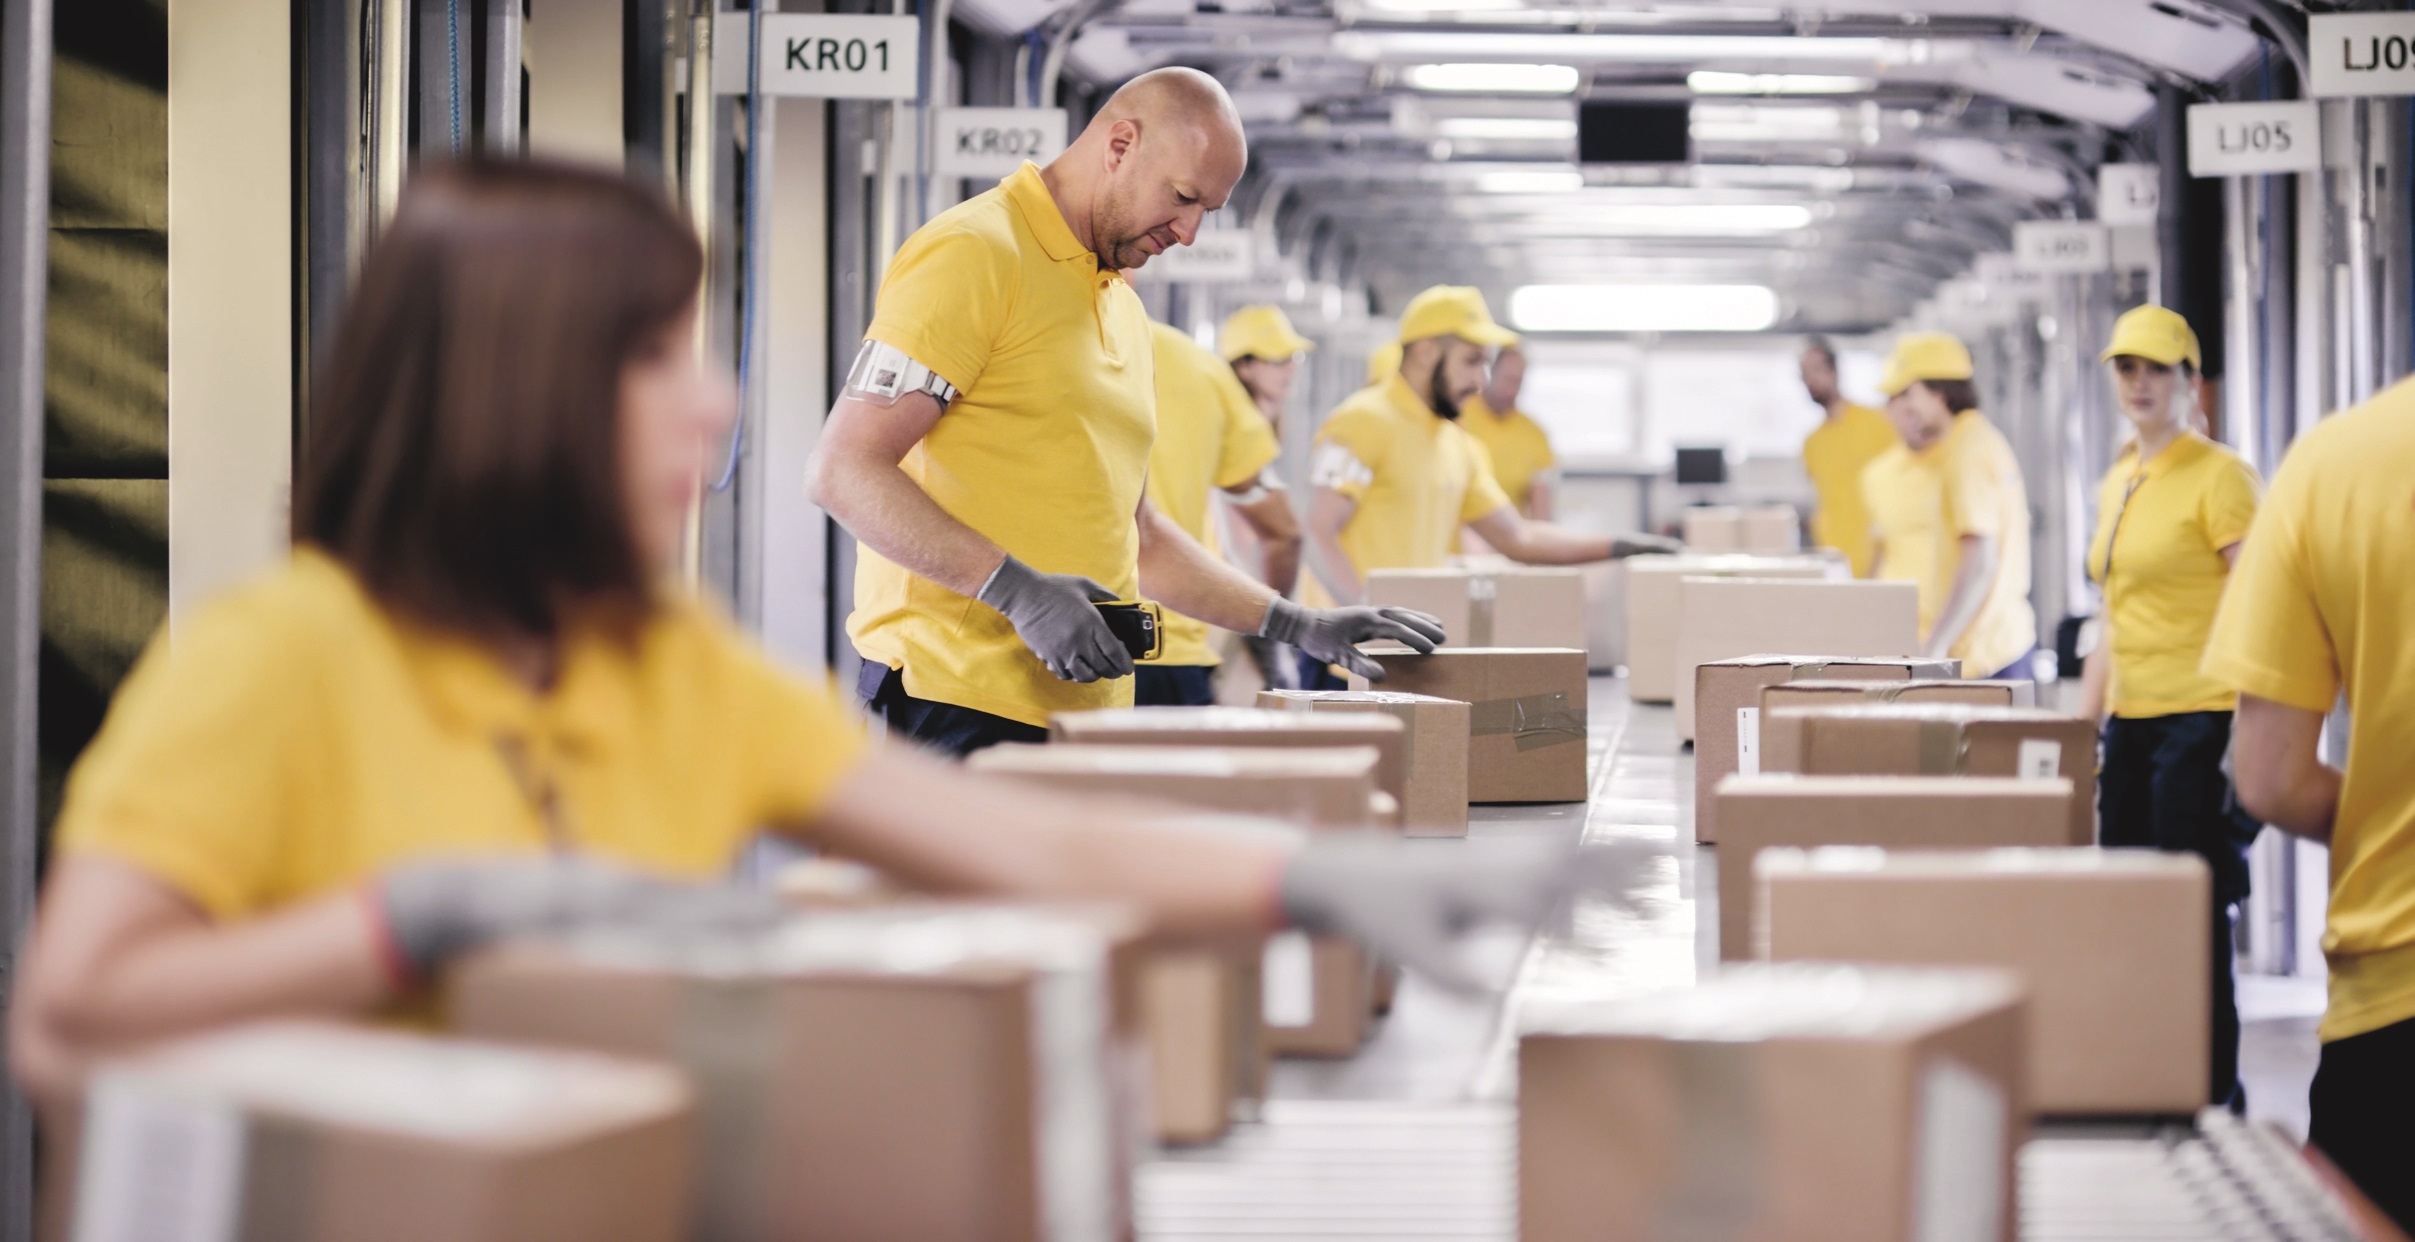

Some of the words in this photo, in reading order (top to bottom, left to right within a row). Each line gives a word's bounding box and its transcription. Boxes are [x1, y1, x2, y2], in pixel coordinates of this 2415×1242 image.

[785, 37, 888, 72] KR01
[2343, 34, 2415, 72] LJ0
[956, 127, 1043, 156] KR02
[2217, 120, 2292, 154] LJ05
